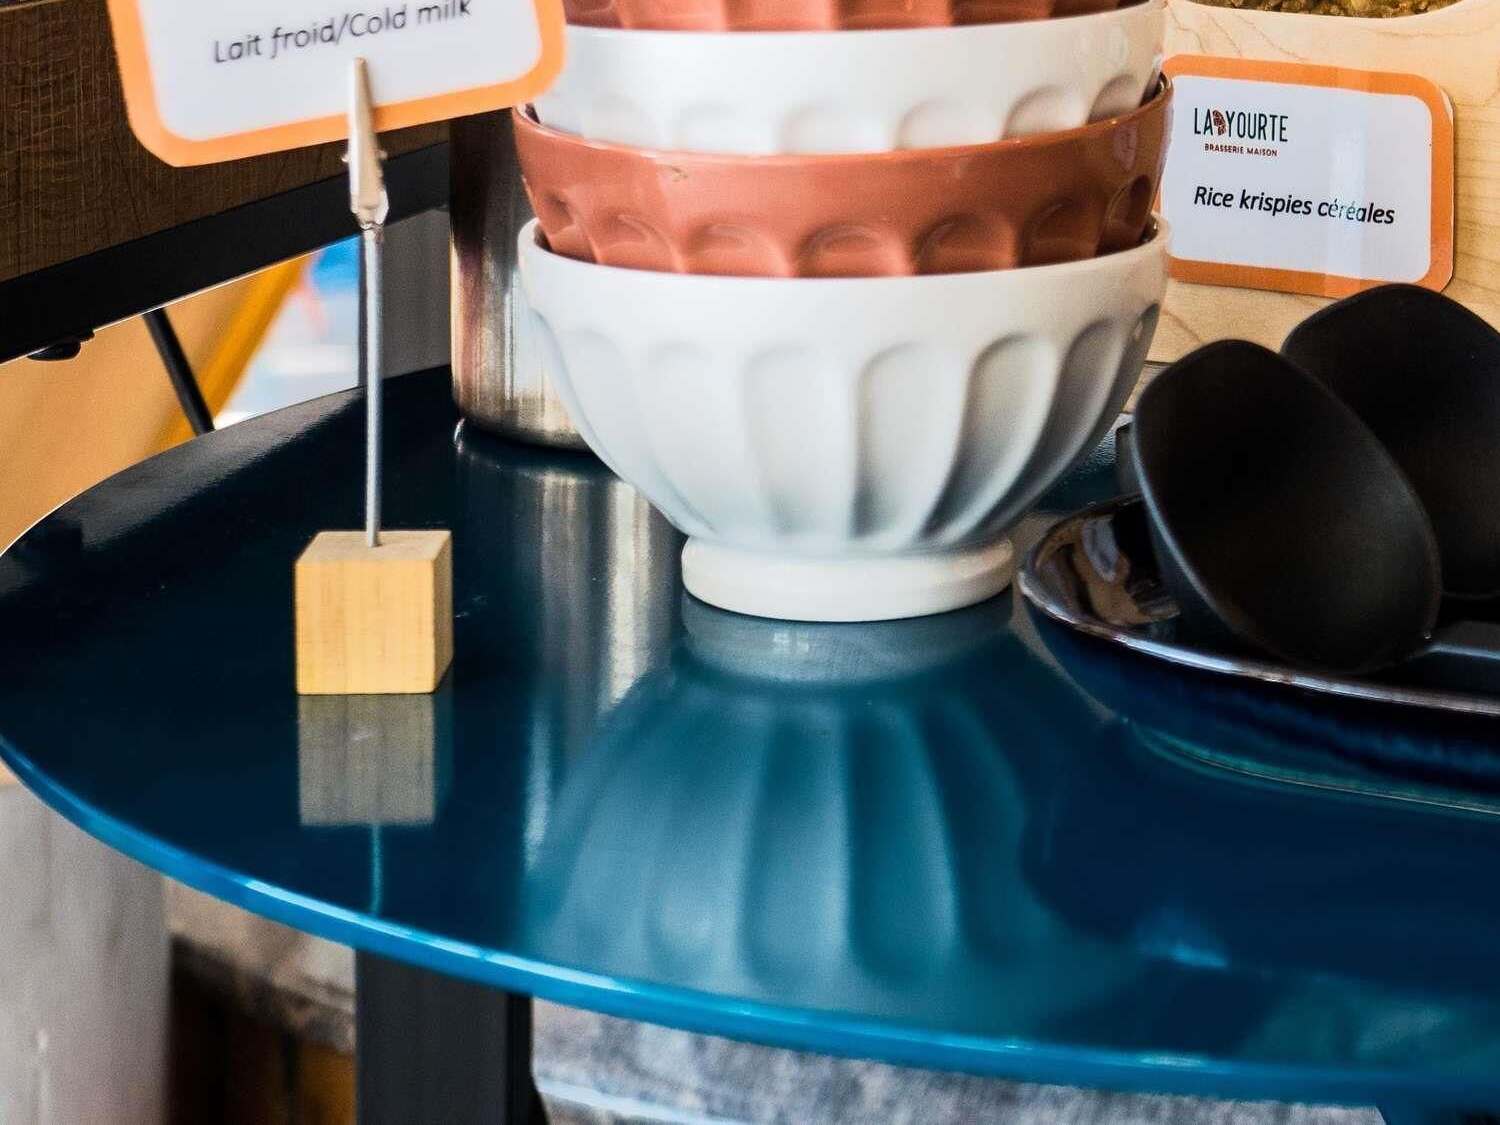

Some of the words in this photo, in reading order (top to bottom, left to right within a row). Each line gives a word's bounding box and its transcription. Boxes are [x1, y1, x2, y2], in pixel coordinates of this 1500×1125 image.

[214, 35, 262, 63] Lait
[271, 4, 407, 59] froid/Cold
[1193, 107, 1214, 136] LA
[1225, 111, 1289, 143] YOURTE
[1204, 144, 1244, 155] BRASSERIE
[1246, 146, 1278, 157] MAISON
[1194, 186, 1234, 208] Rice
[1239, 189, 1313, 217] krispies
[1317, 198, 1396, 225] céréales
